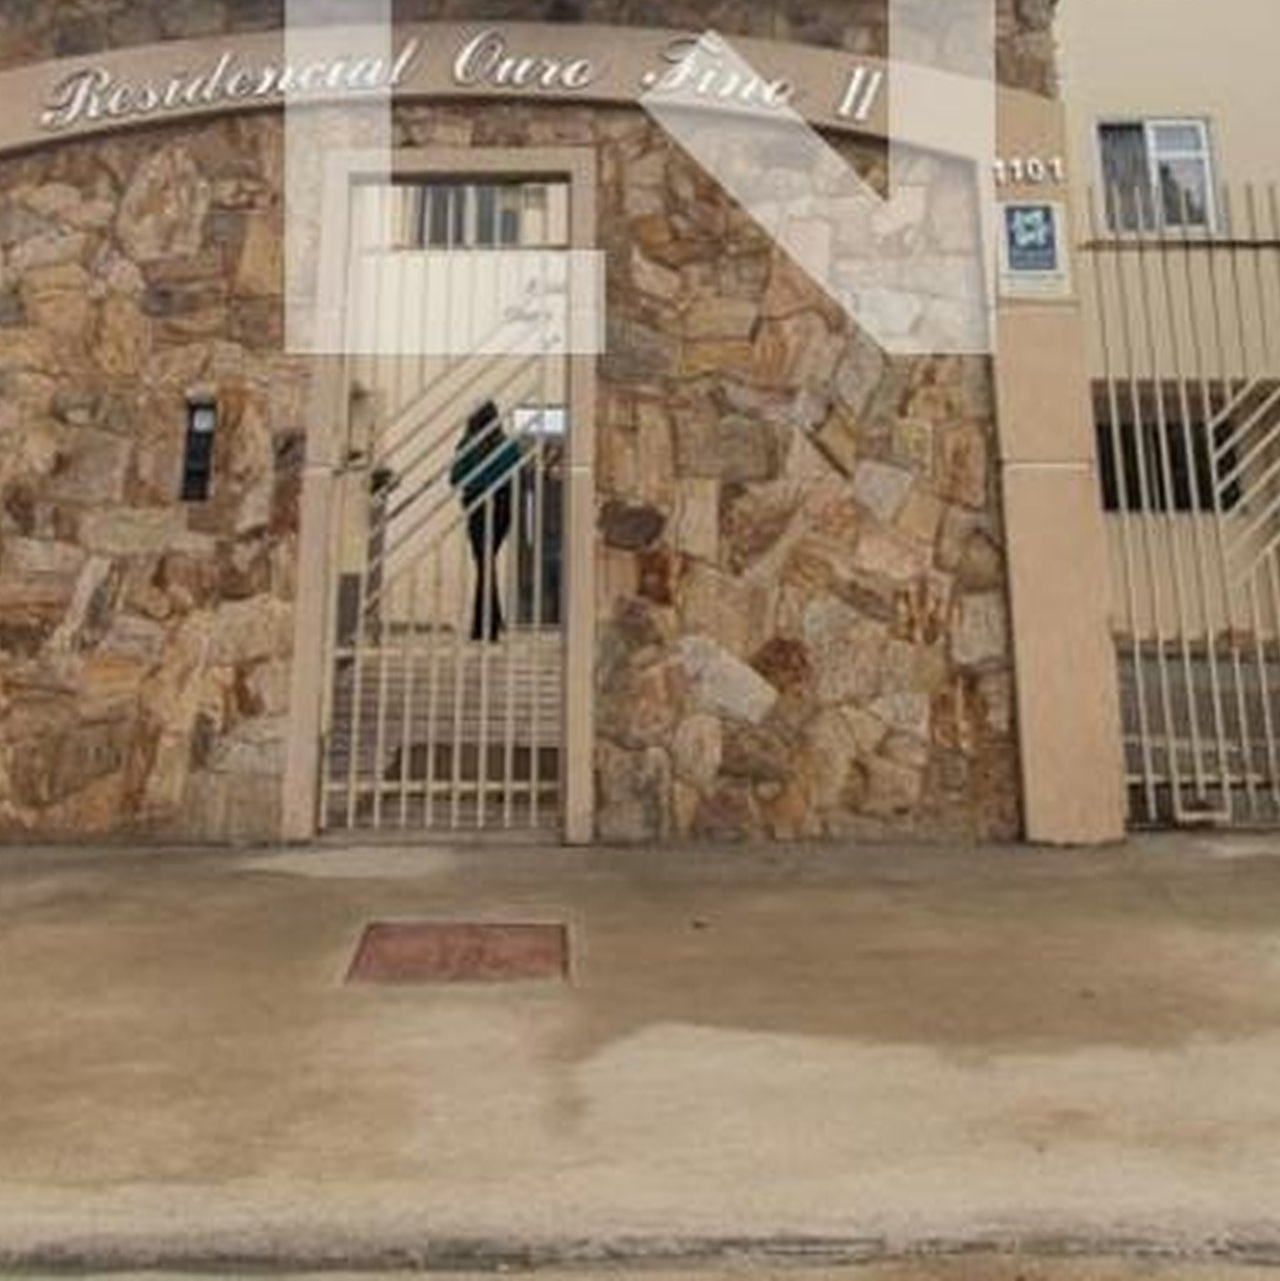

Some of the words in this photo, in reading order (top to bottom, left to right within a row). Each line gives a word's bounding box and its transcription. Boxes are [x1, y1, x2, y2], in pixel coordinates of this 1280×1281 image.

[40, 37, 419, 124] Residencial
[452, 28, 594, 87] Ouro
[641, 37, 794, 106] Fino
[993, 157, 1064, 183] 1101
